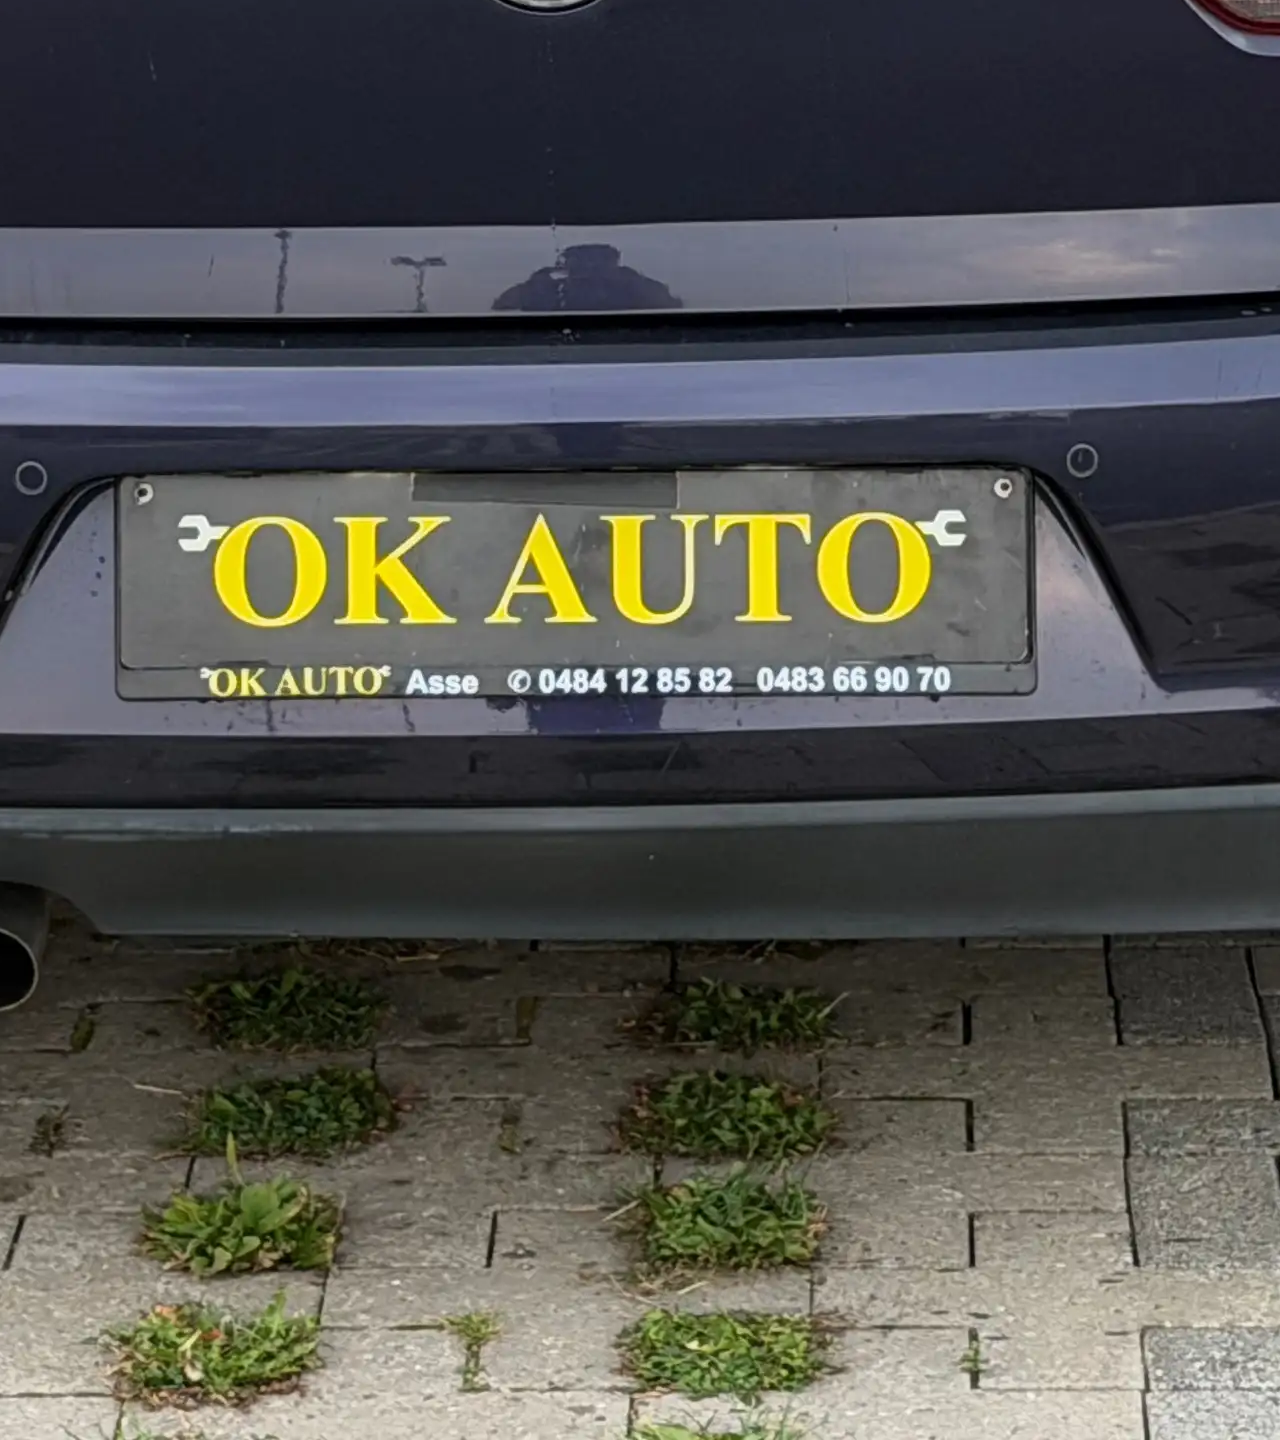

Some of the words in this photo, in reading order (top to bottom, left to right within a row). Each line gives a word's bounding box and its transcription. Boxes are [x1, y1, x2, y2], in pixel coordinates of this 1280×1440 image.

[214, 515, 456, 627] OK
[485, 511, 931, 625] AUTO
[208, 667, 266, 697] OK
[274, 666, 383, 696] AUTO
[406, 670, 479, 695] Asse
[538, 668, 608, 694] 0484
[616, 667, 649, 694] 12
[656, 667, 692, 693] 85
[698, 667, 734, 693] 82
[756, 666, 825, 693] 0483
[833, 666, 868, 692] 66
[875, 666, 910, 692] 90
[918, 666, 952, 692] 70
